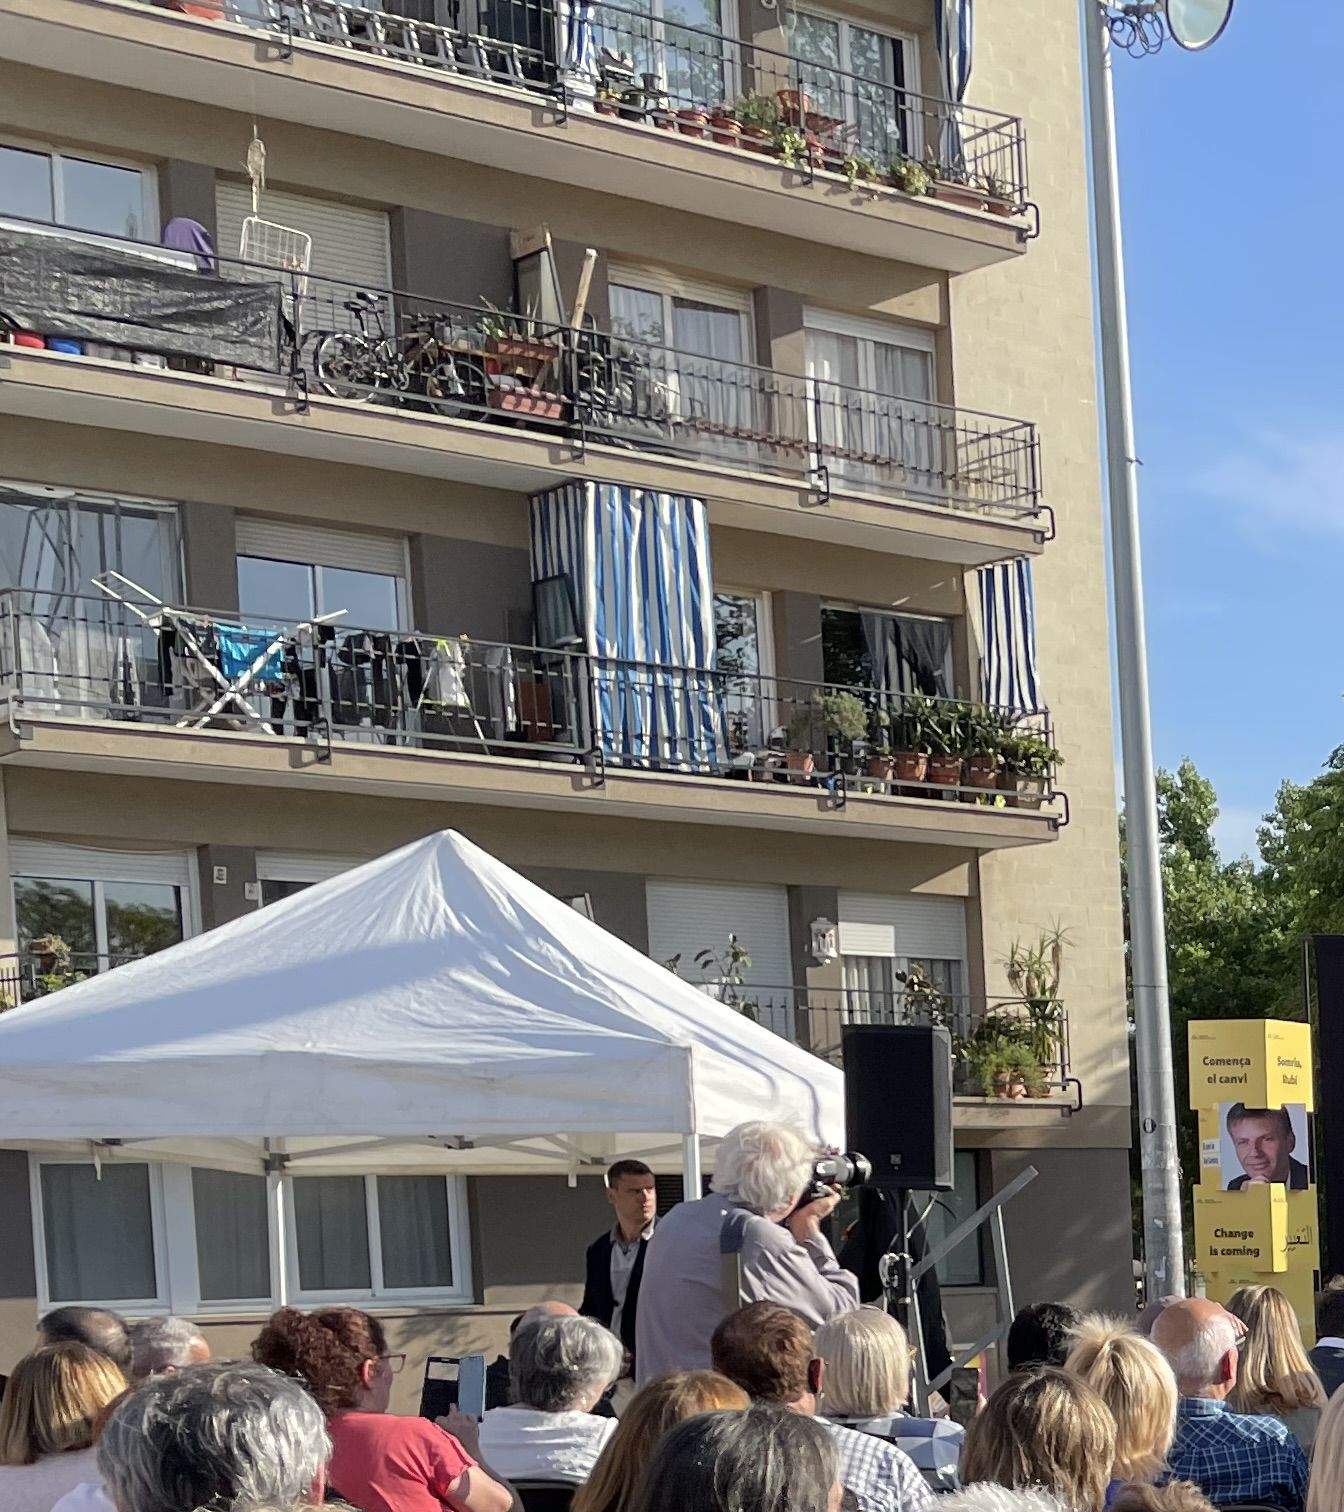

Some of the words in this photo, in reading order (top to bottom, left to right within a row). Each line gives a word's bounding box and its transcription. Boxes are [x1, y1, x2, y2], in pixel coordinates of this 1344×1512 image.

[1202, 1056, 1251, 1069] Comença
[1207, 1073, 1217, 1084] el
[1220, 1073, 1248, 1084] canvi
[1214, 1228, 1254, 1240] Change
[1209, 1245, 1218, 1256] is
[1221, 1245, 1260, 1258] coming
